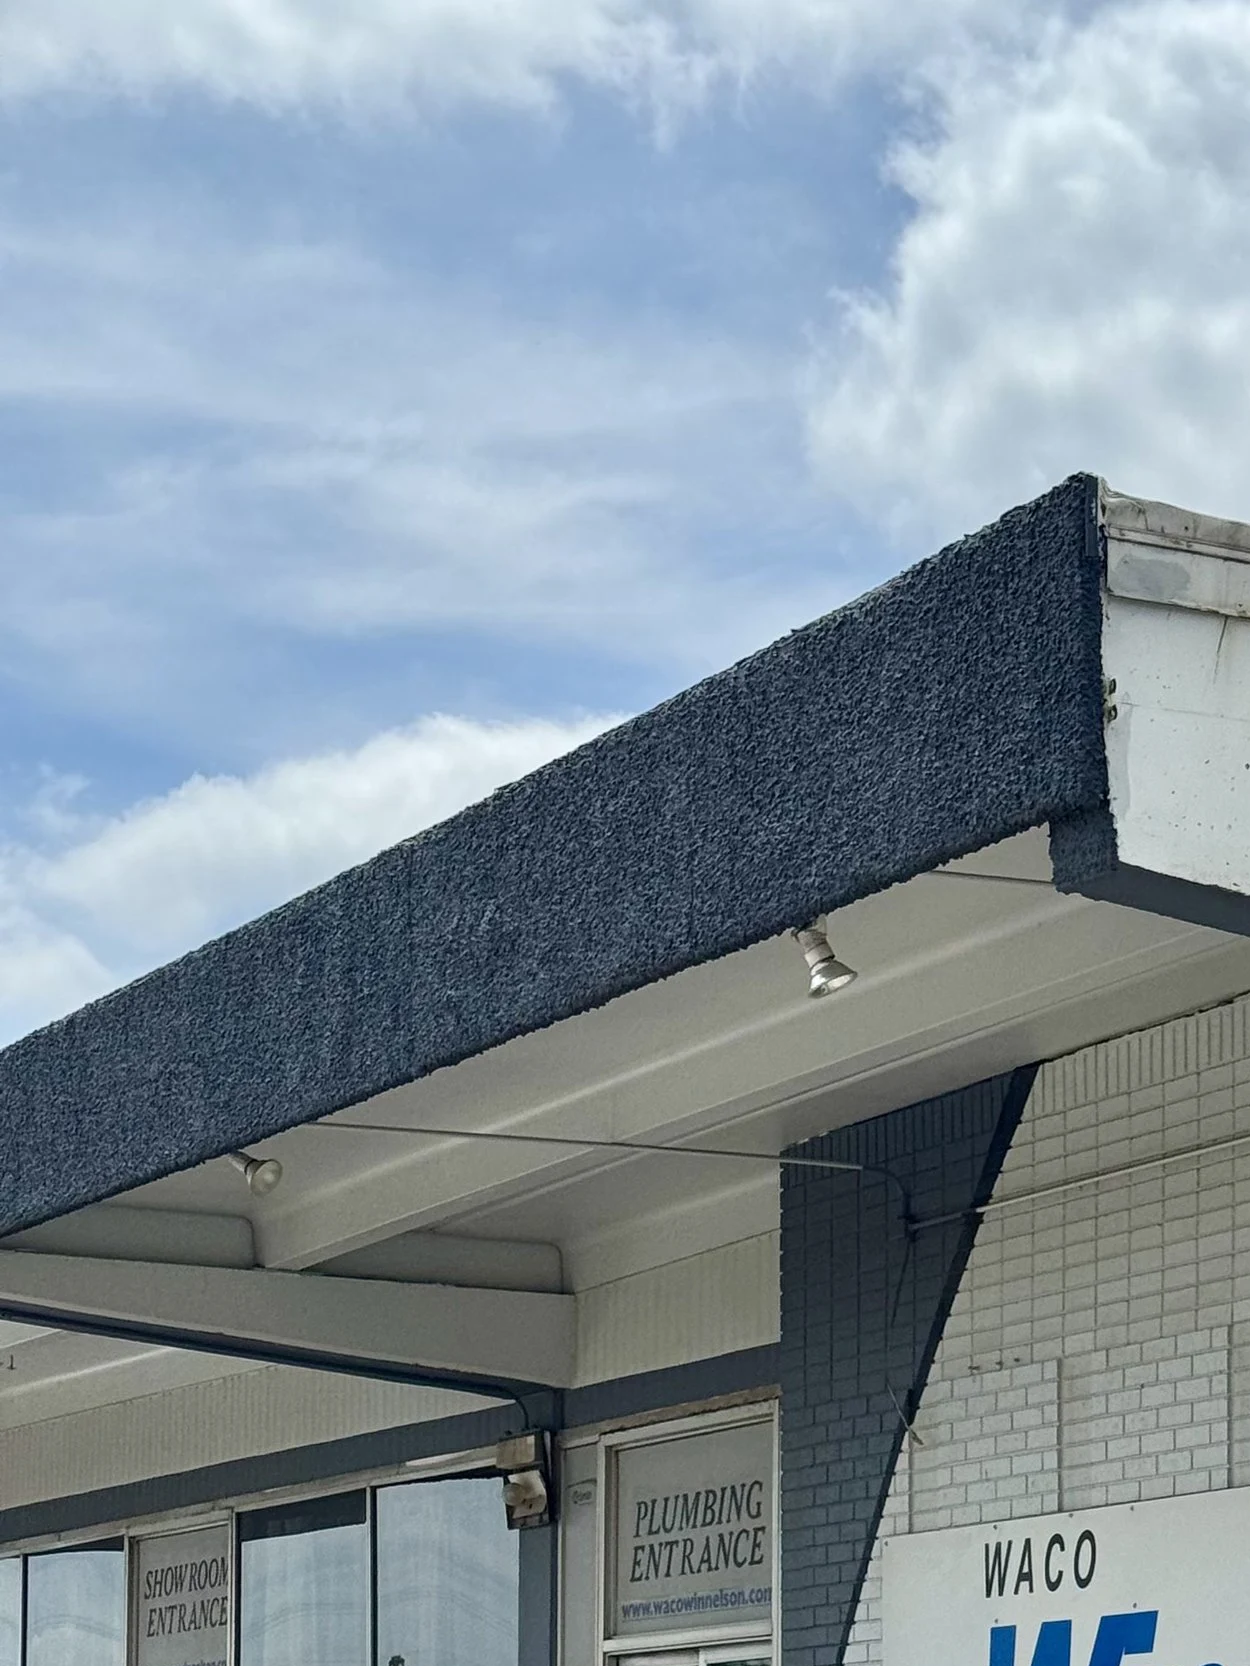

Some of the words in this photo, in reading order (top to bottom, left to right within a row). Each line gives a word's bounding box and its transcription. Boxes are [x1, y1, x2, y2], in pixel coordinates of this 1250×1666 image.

[633, 1480, 763, 1538] PLUMBING
[629, 1526, 766, 1583] ENTRANCE
[985, 1529, 1096, 1598] WACO
[146, 1596, 228, 1637] ENTRANCE
